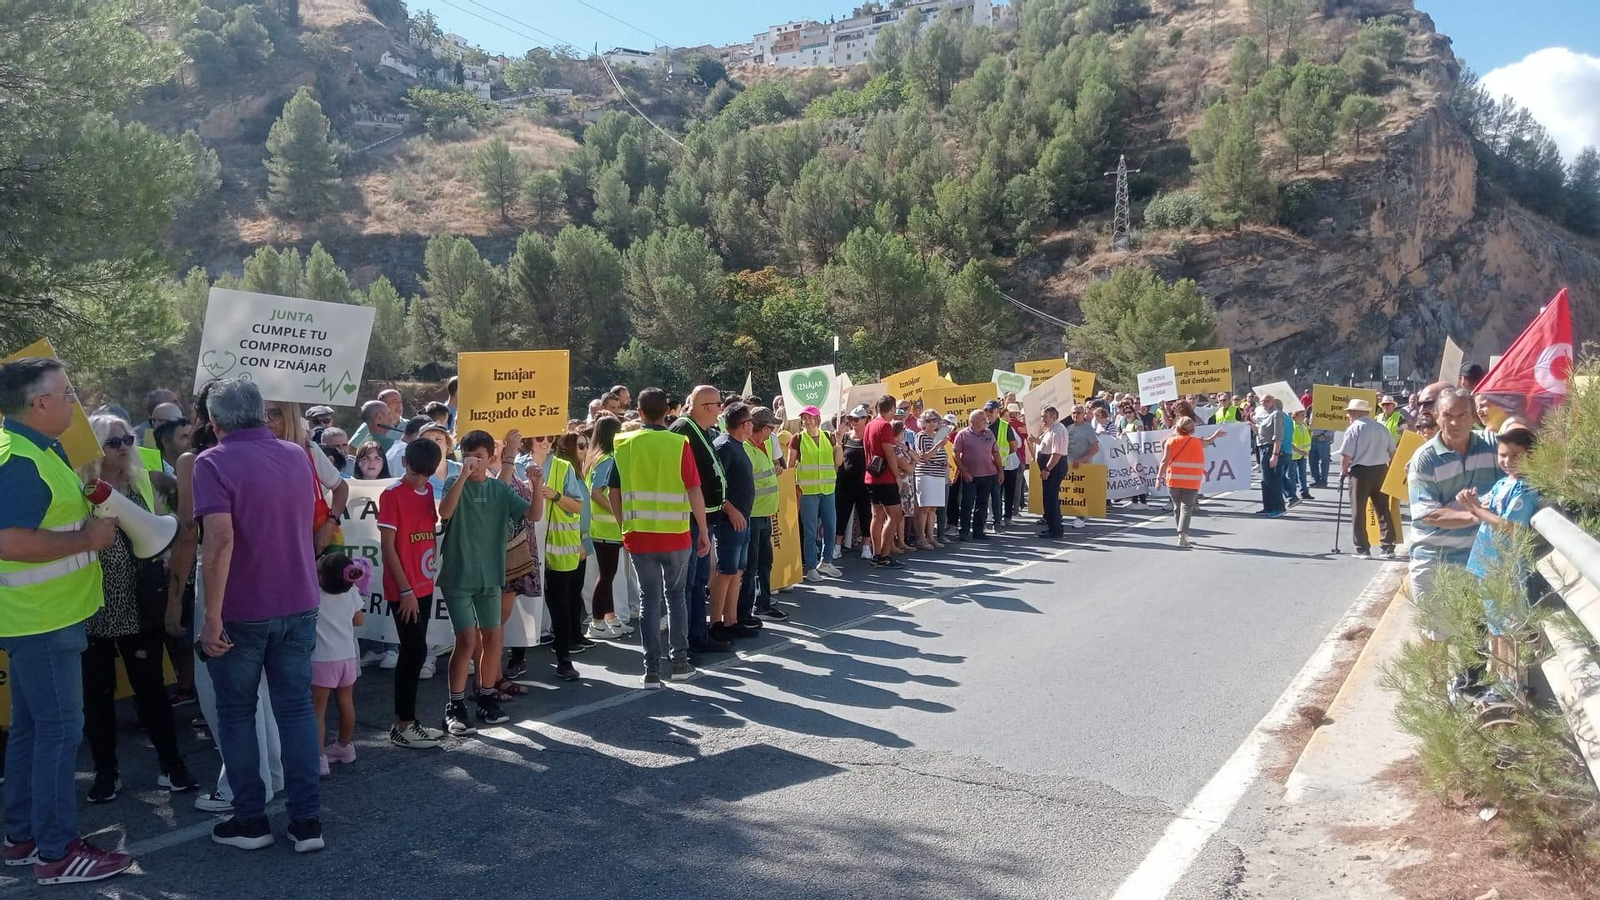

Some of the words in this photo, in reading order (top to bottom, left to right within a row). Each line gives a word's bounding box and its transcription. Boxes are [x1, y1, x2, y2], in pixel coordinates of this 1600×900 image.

[270, 309, 314, 323] JUNTA
[252, 323, 306, 338] CUMPLE
[311, 330, 327, 340] TU
[240, 339, 332, 358] COMPROMISO
[240, 356, 269, 368] CON
[273, 359, 327, 373] IZNÁJAR
[493, 367, 536, 383] Iznájar
[1175, 369, 1196, 378] argen
[1197, 366, 1230, 377] izquierdo
[796, 380, 824, 391] IZNÁJAR
[899, 376, 921, 389] Iznájar
[496, 391, 518, 404] por
[521, 390, 536, 399] su
[805, 393, 819, 401] SOS
[902, 390, 914, 399] por
[944, 394, 977, 405] Iznájar
[1332, 395, 1349, 403] Iznáj
[469, 407, 519, 423] Juzgado
[522, 405, 536, 417] de
[539, 404, 559, 416] Paz
[1315, 412, 1343, 420] colegios
[1065, 472, 1086, 483] ájar
[1060, 497, 1086, 507] nidad
[771, 510, 782, 549] znájar
